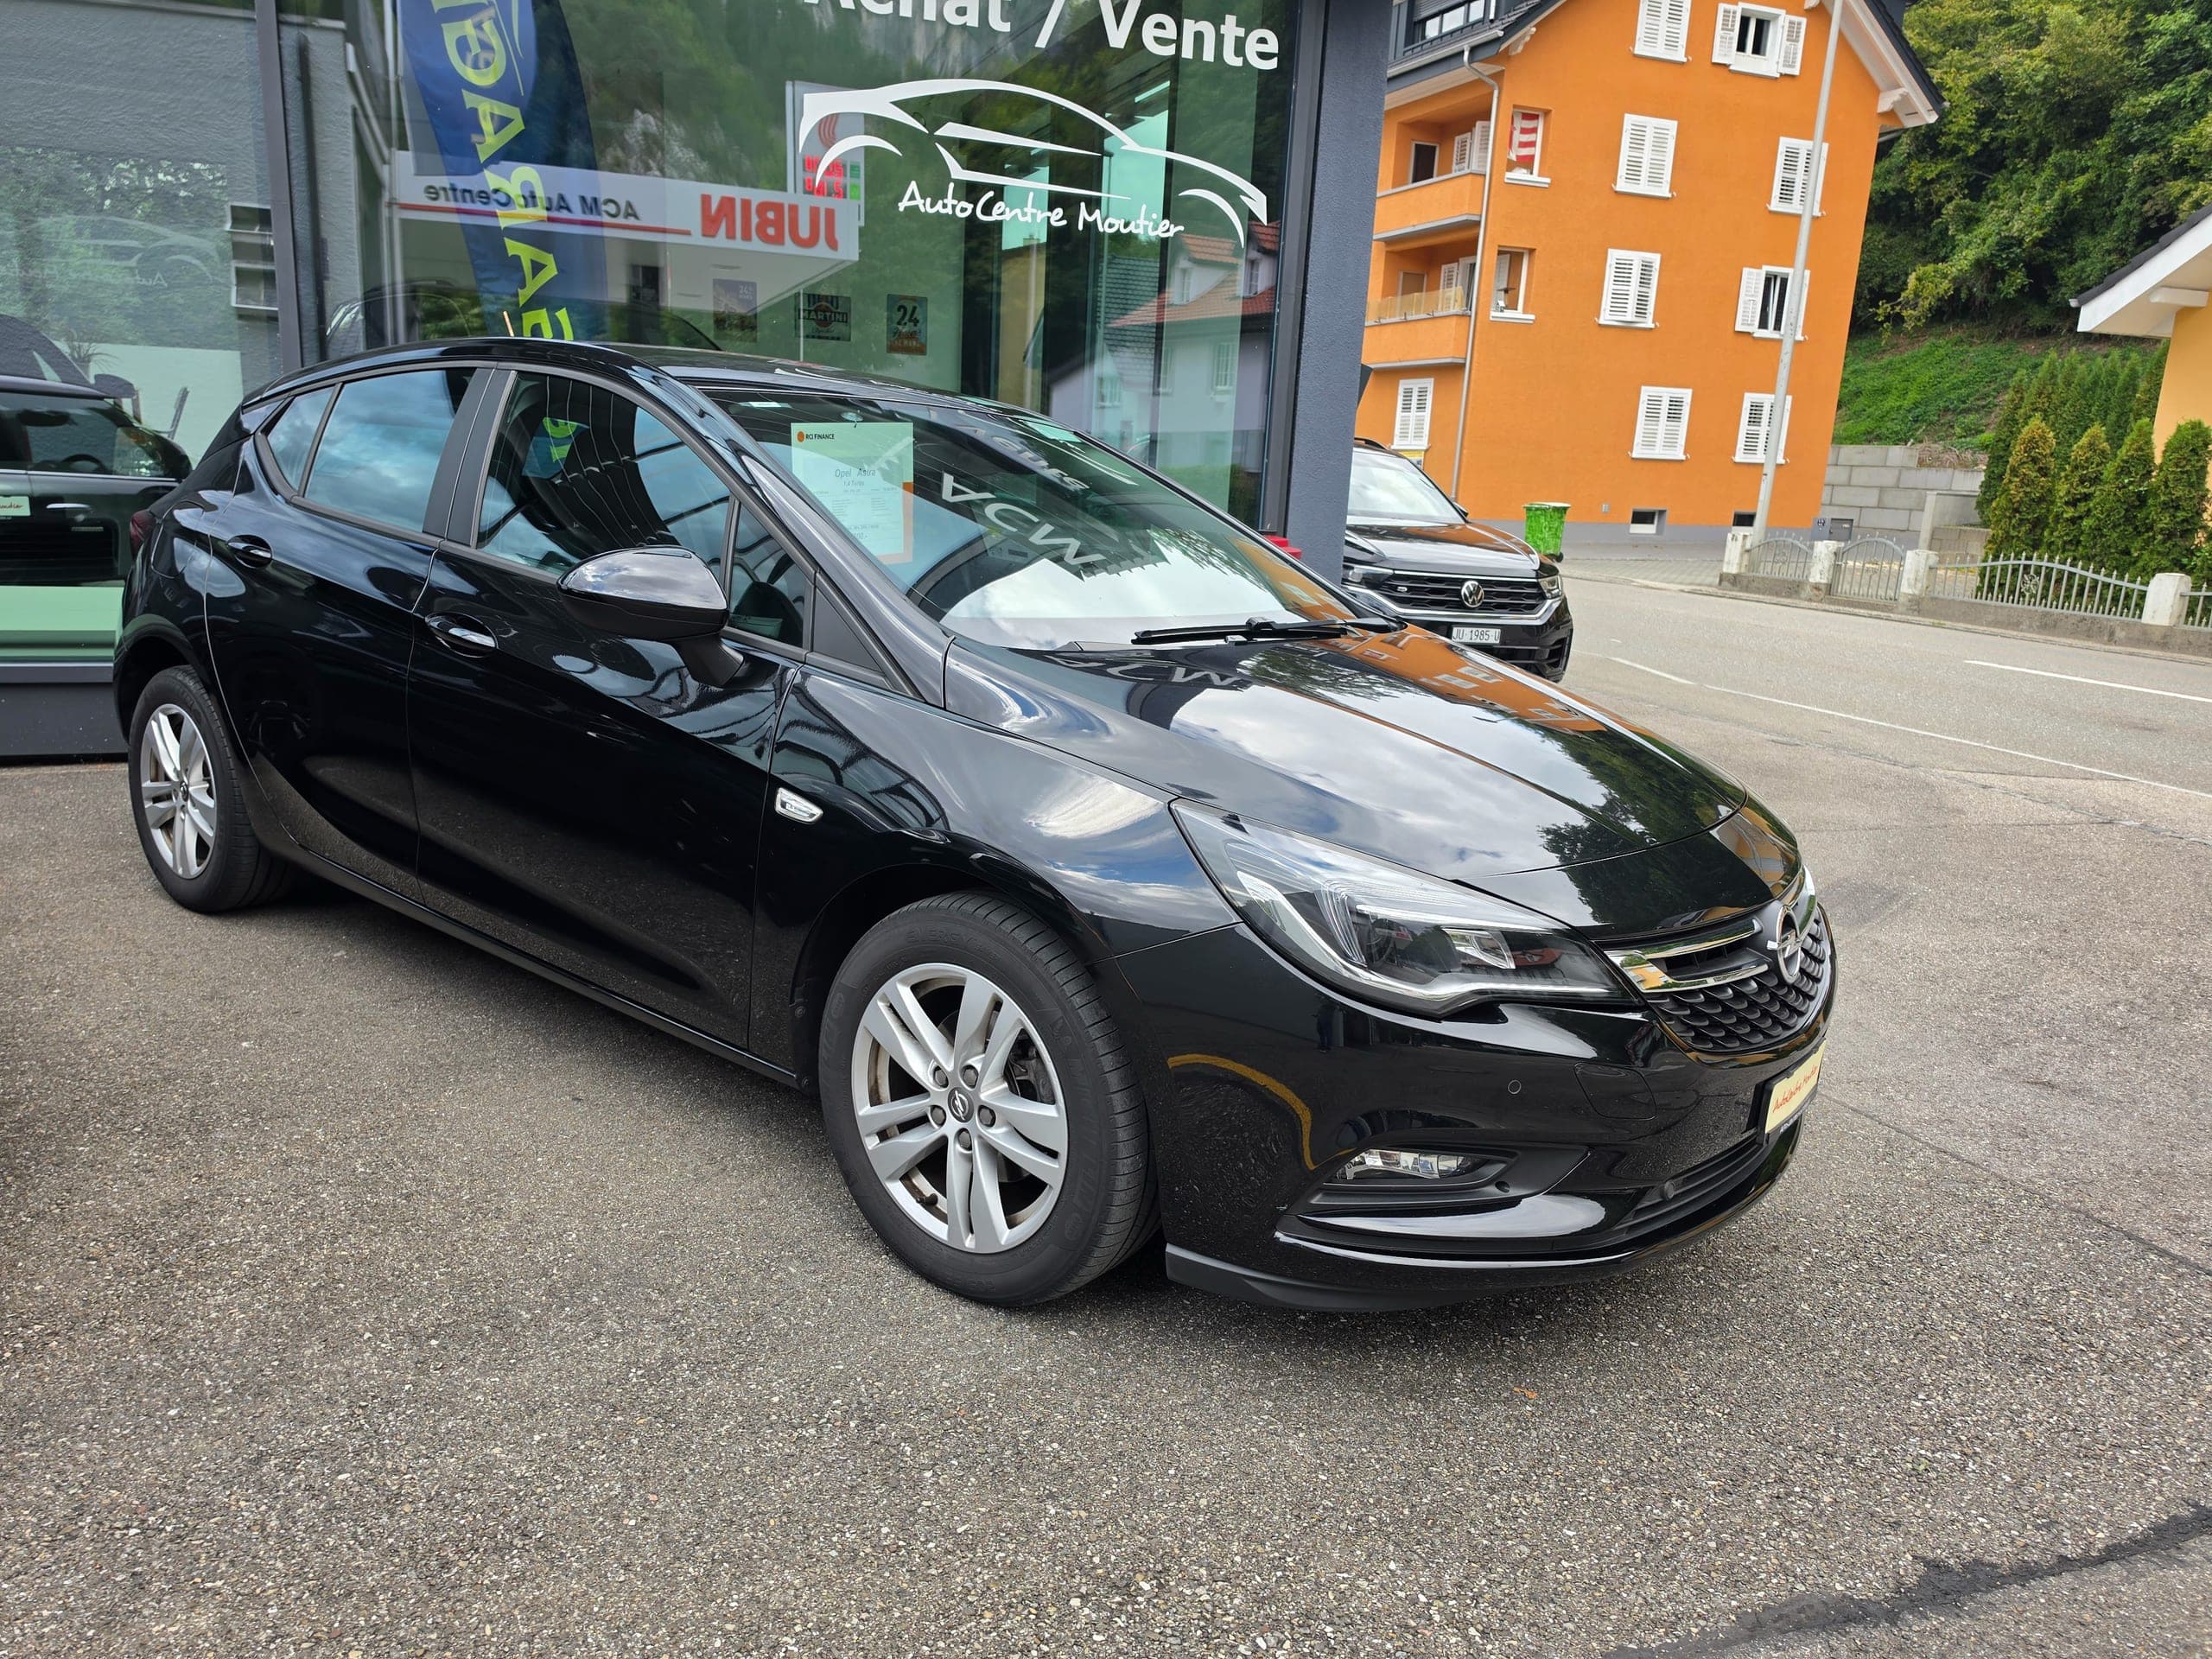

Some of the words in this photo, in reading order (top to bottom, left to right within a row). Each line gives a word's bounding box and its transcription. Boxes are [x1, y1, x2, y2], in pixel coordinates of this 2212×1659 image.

[1099, 0, 1279, 70] Vente
[1077, 201, 1185, 238] Moutier
[897, 304, 919, 327] 24
[835, 468, 852, 479] Opel
[1469, 629, 1491, 641] 1985
